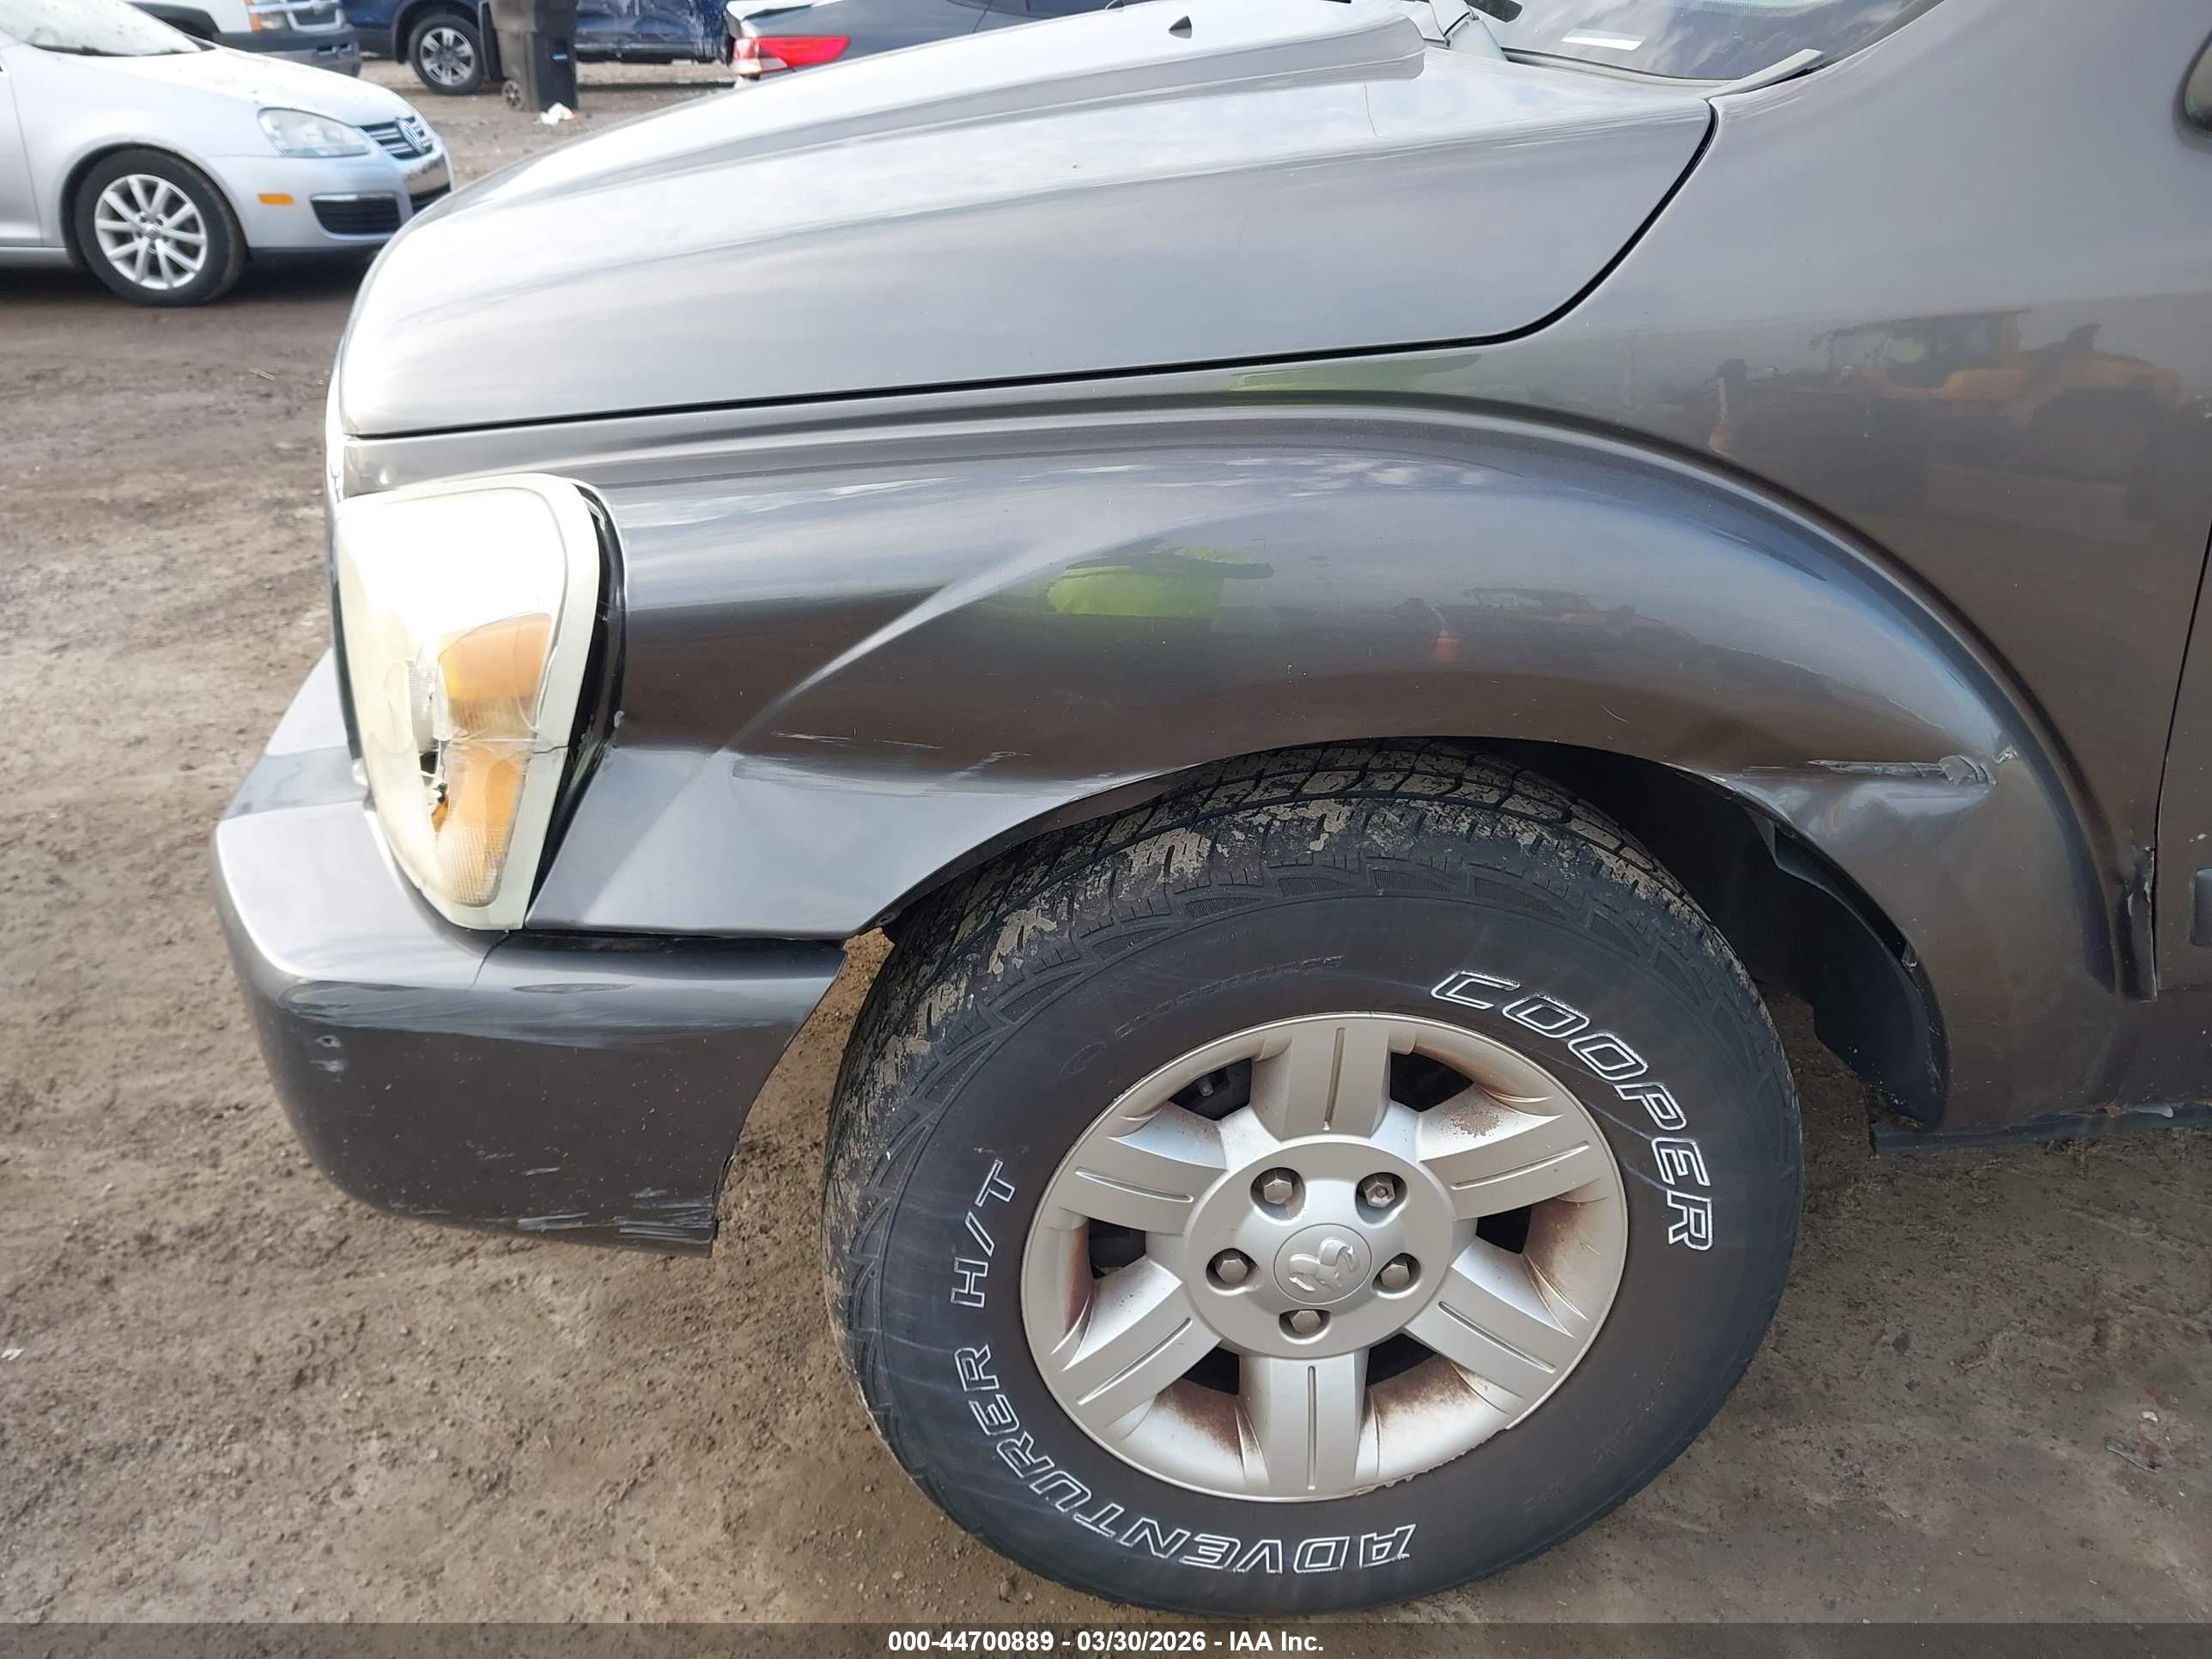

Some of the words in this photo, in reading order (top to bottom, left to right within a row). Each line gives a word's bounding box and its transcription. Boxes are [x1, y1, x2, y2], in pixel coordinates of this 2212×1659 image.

[1431, 970, 1713, 1251] COOPER
[951, 1159, 1016, 1308] H/T
[954, 1344, 1417, 1574] ADVENTURER
